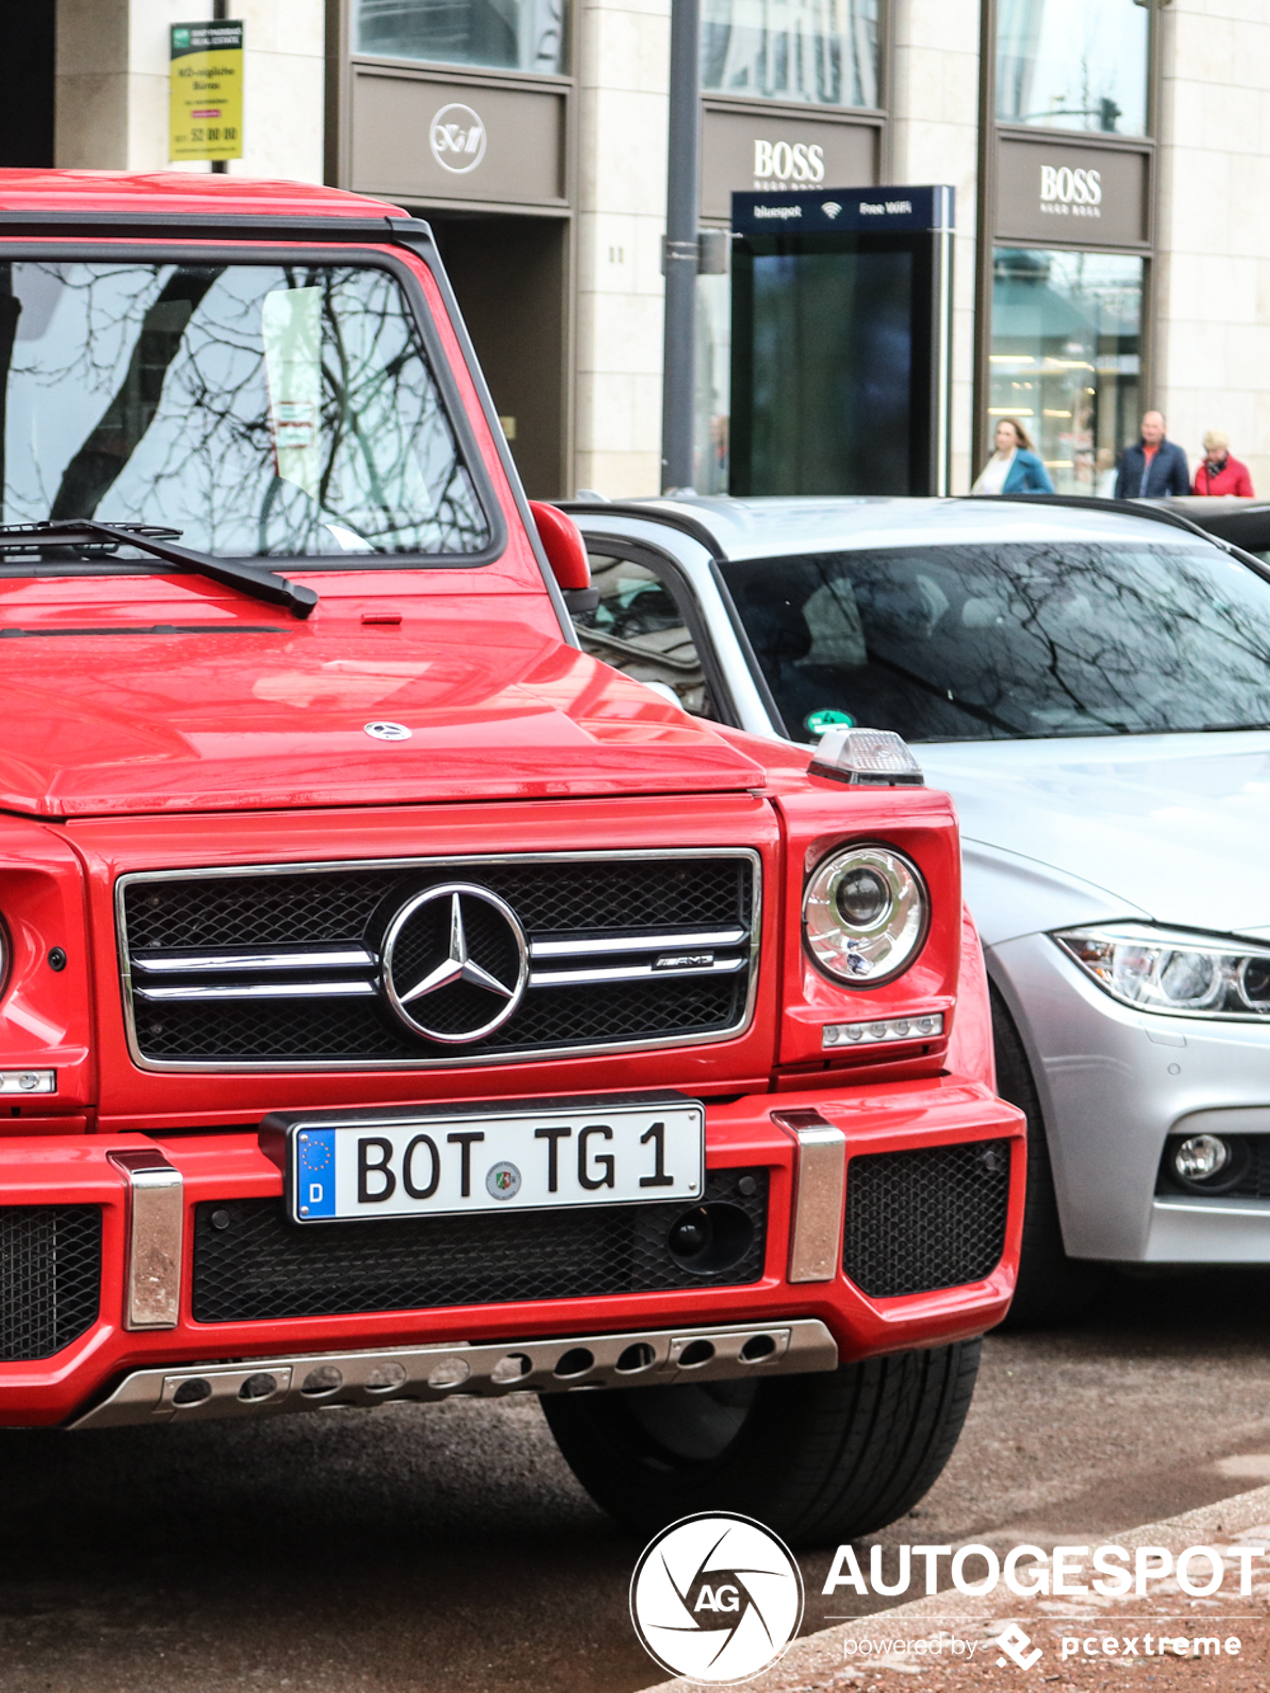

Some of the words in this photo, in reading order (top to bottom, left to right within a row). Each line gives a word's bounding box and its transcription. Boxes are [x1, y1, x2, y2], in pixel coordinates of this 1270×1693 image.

[754, 139, 825, 182] BOSS
[1040, 165, 1102, 205] BOSS
[859, 202, 884, 215] Free
[885, 200, 912, 215] WiFi
[357, 1131, 485, 1204] BOT
[534, 1124, 615, 1193] TG
[639, 1122, 674, 1188] 1
[309, 1183, 324, 1203] D
